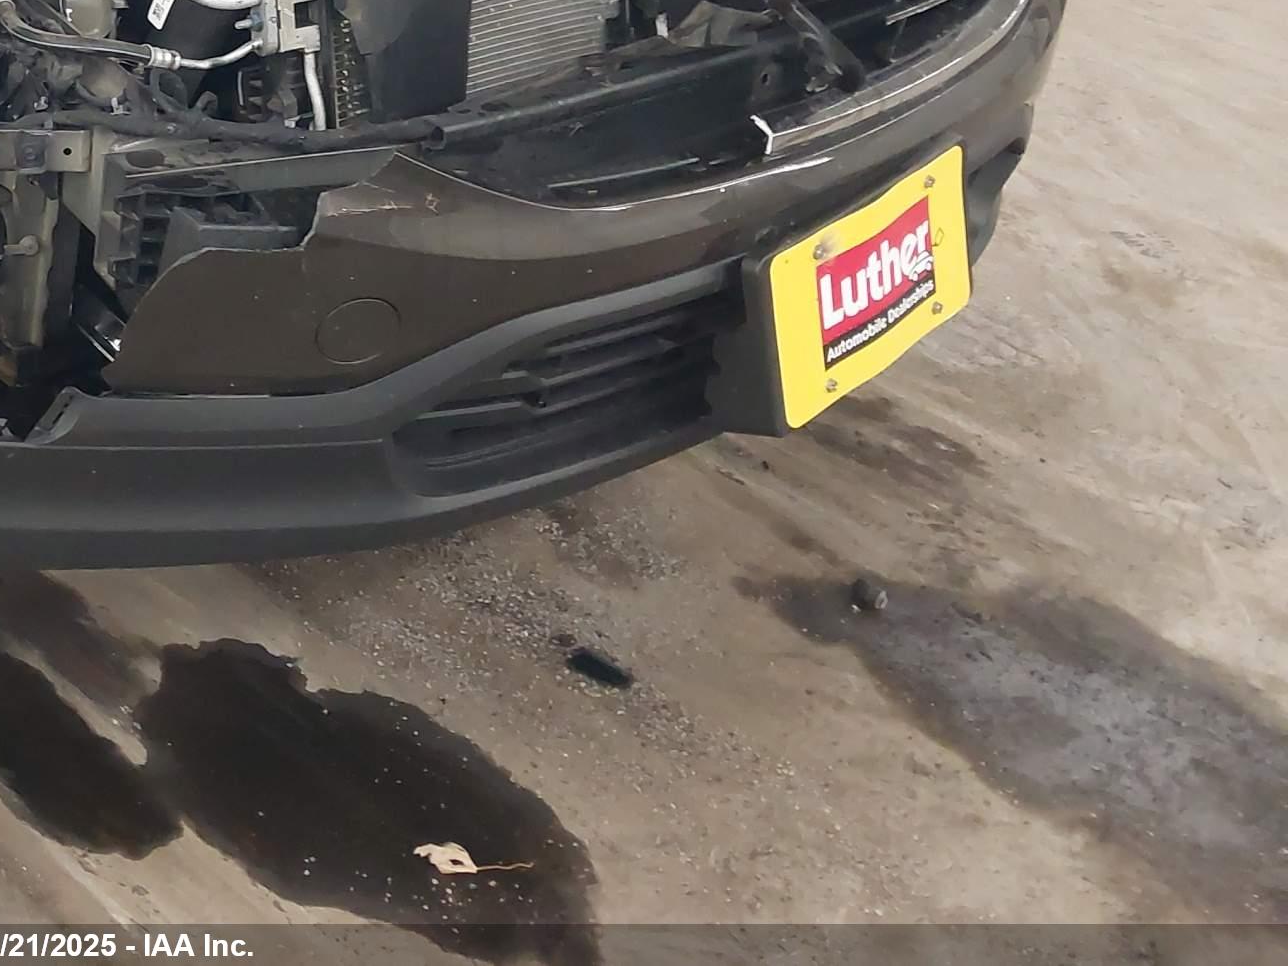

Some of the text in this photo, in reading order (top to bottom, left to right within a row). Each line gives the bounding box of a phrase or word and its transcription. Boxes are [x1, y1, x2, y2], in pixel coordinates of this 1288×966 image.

[819, 220, 929, 330] Luther
[826, 279, 934, 363] Automobile Dealerships
